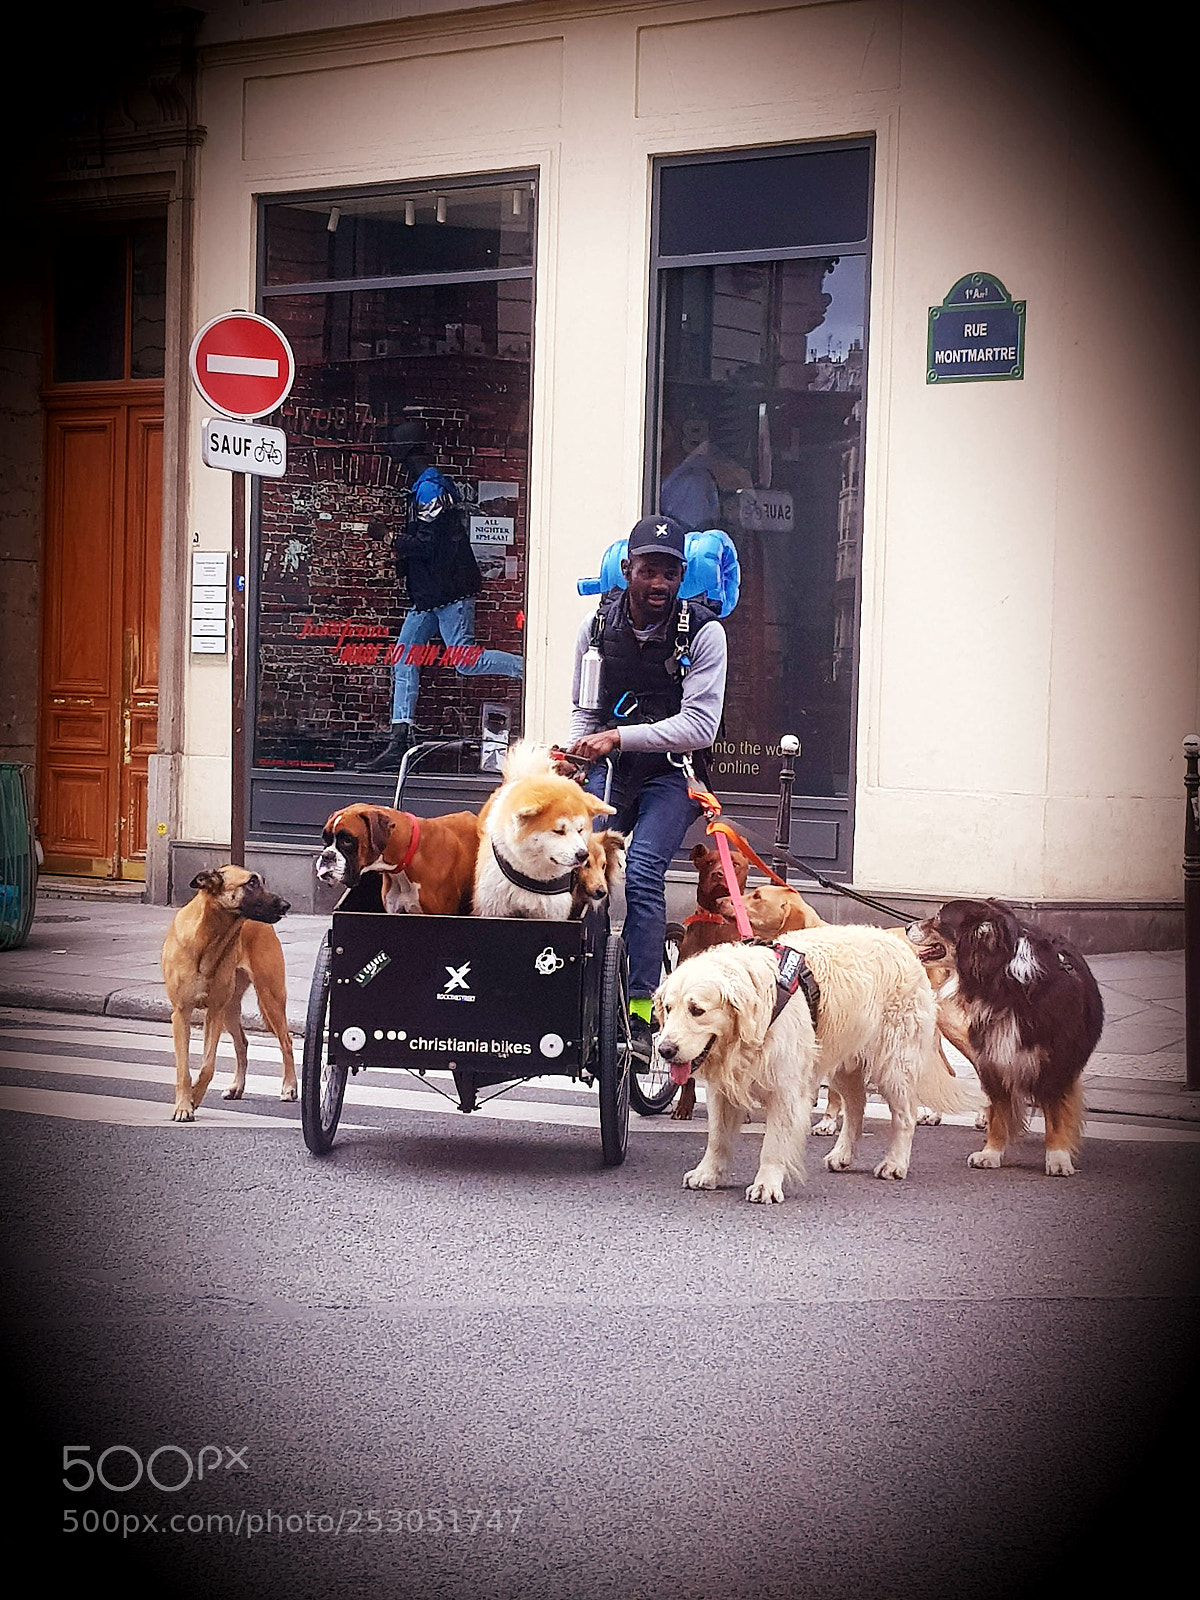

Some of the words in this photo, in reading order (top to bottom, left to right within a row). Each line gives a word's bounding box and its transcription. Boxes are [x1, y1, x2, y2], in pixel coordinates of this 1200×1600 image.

[964, 323, 988, 337] RUE
[935, 346, 1016, 364] MONTMARTRE
[210, 432, 252, 457] SAUF
[475, 526, 510, 534] NIGHTER
[382, 643, 405, 666] TO
[404, 643, 441, 666] RUN
[439, 644, 486, 667] AWAY
[740, 741, 761, 756] the
[718, 760, 760, 775] online
[409, 1036, 489, 1052] christiania
[491, 1040, 532, 1054] bikes
